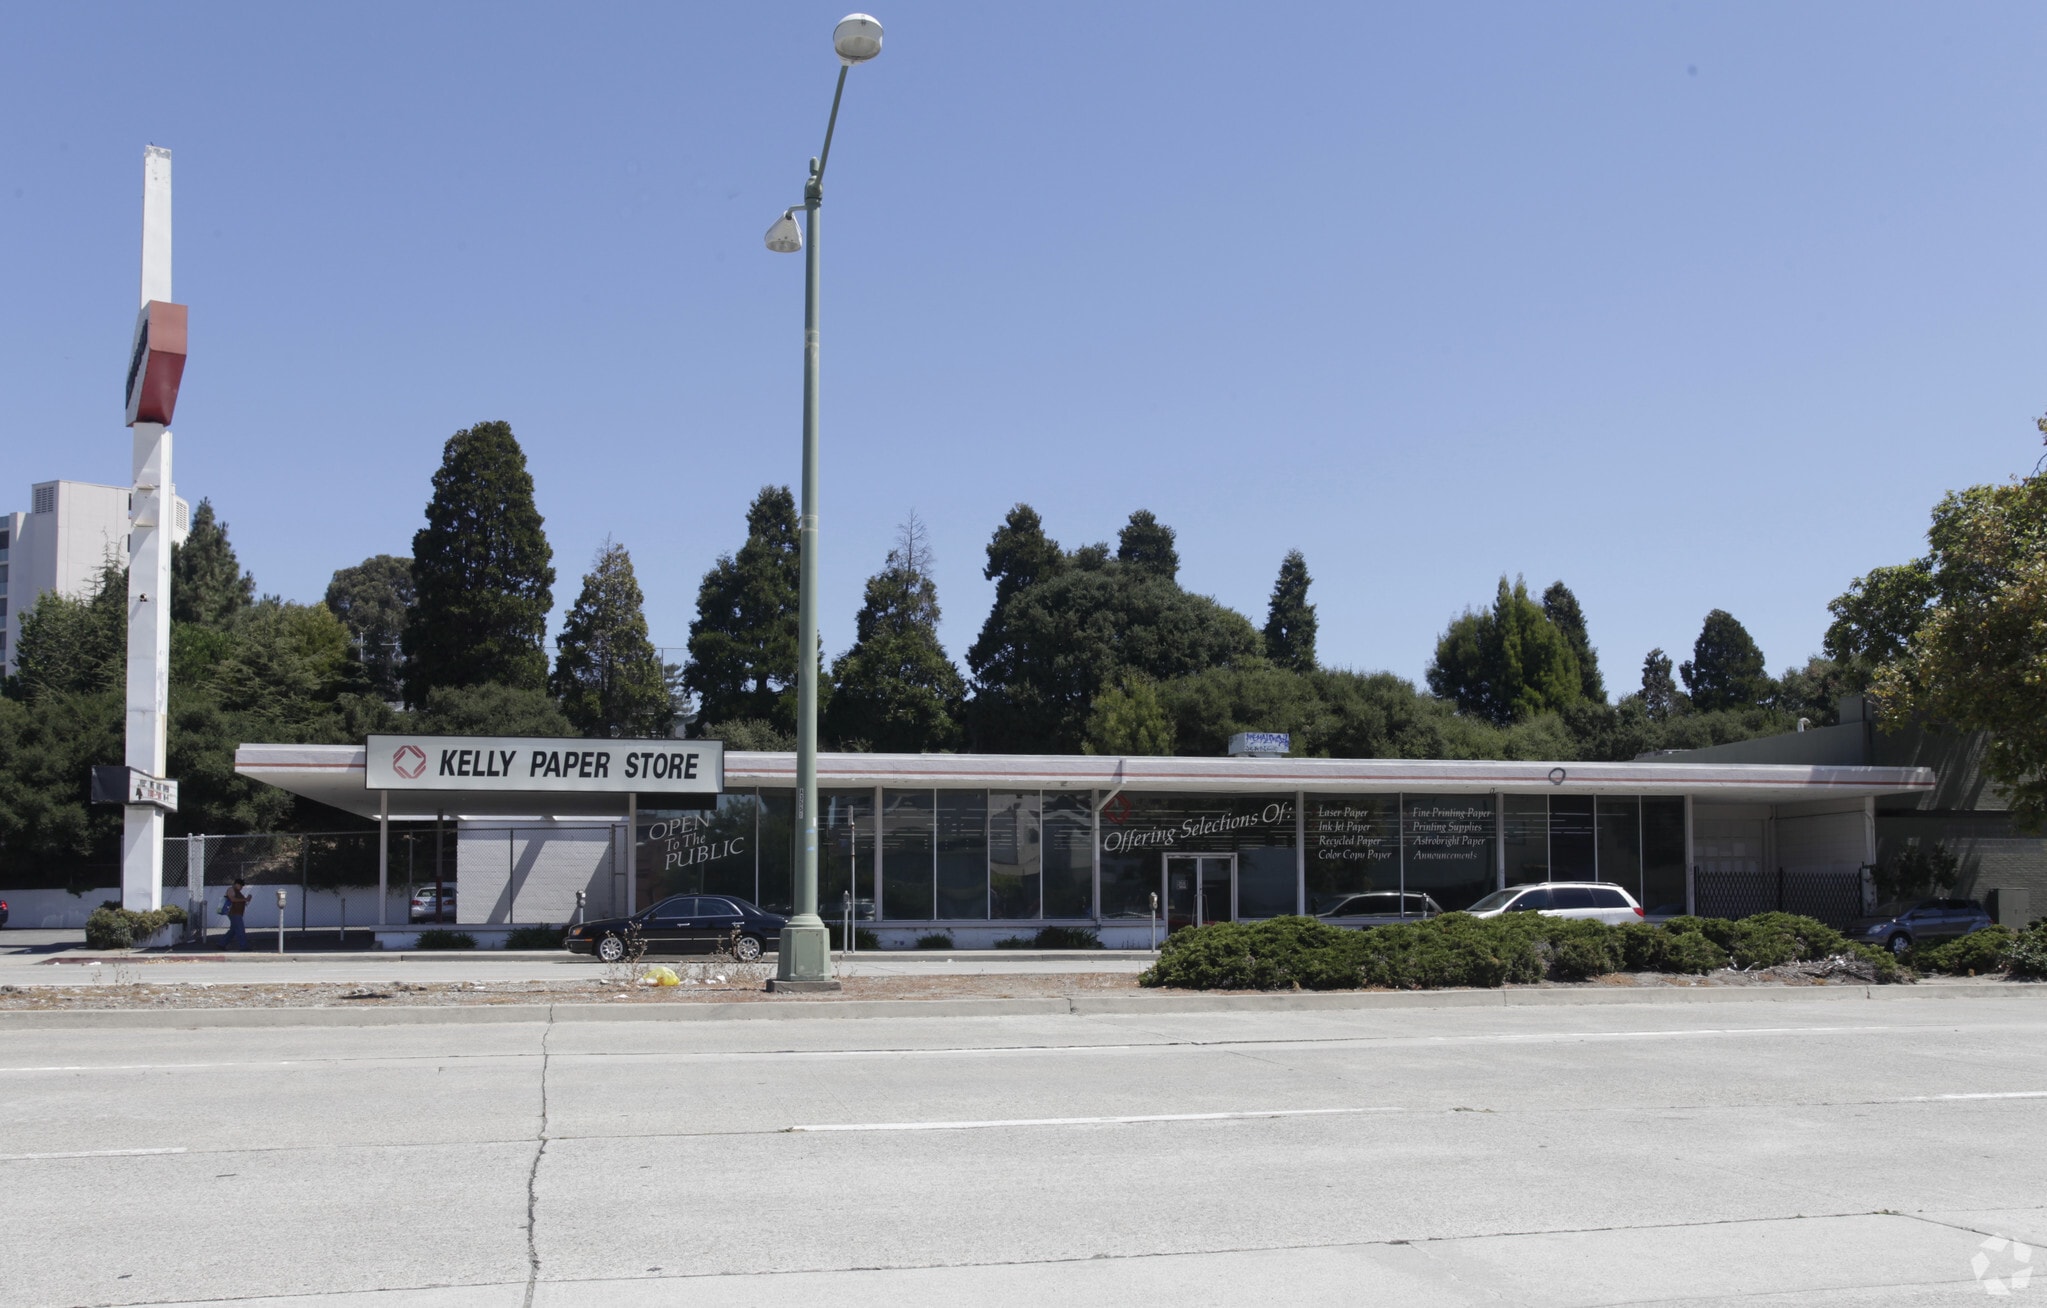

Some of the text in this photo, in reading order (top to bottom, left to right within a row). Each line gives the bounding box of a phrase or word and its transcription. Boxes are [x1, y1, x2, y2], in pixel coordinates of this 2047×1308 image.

[438, 750, 699, 779] KELLY PAPER STORE
[1318, 804, 1368, 819] Laser Paper
[1412, 807, 1491, 819] Fine Printing Paper
[649, 811, 711, 840] OPEN
[1104, 802, 1293, 854] Offering Selections Of:
[1318, 821, 1371, 833] Ink Jet Paper
[1412, 821, 1482, 833] Printing Supplies
[664, 832, 706, 852] To The
[1318, 834, 1382, 847] Recycled Paper
[1412, 835, 1486, 847] Astrobright Paper
[665, 837, 744, 871] PUBLIC
[1318, 848, 1341, 860] Color
[1367, 849, 1393, 861] Paper
[1413, 849, 1478, 860] Announcements
